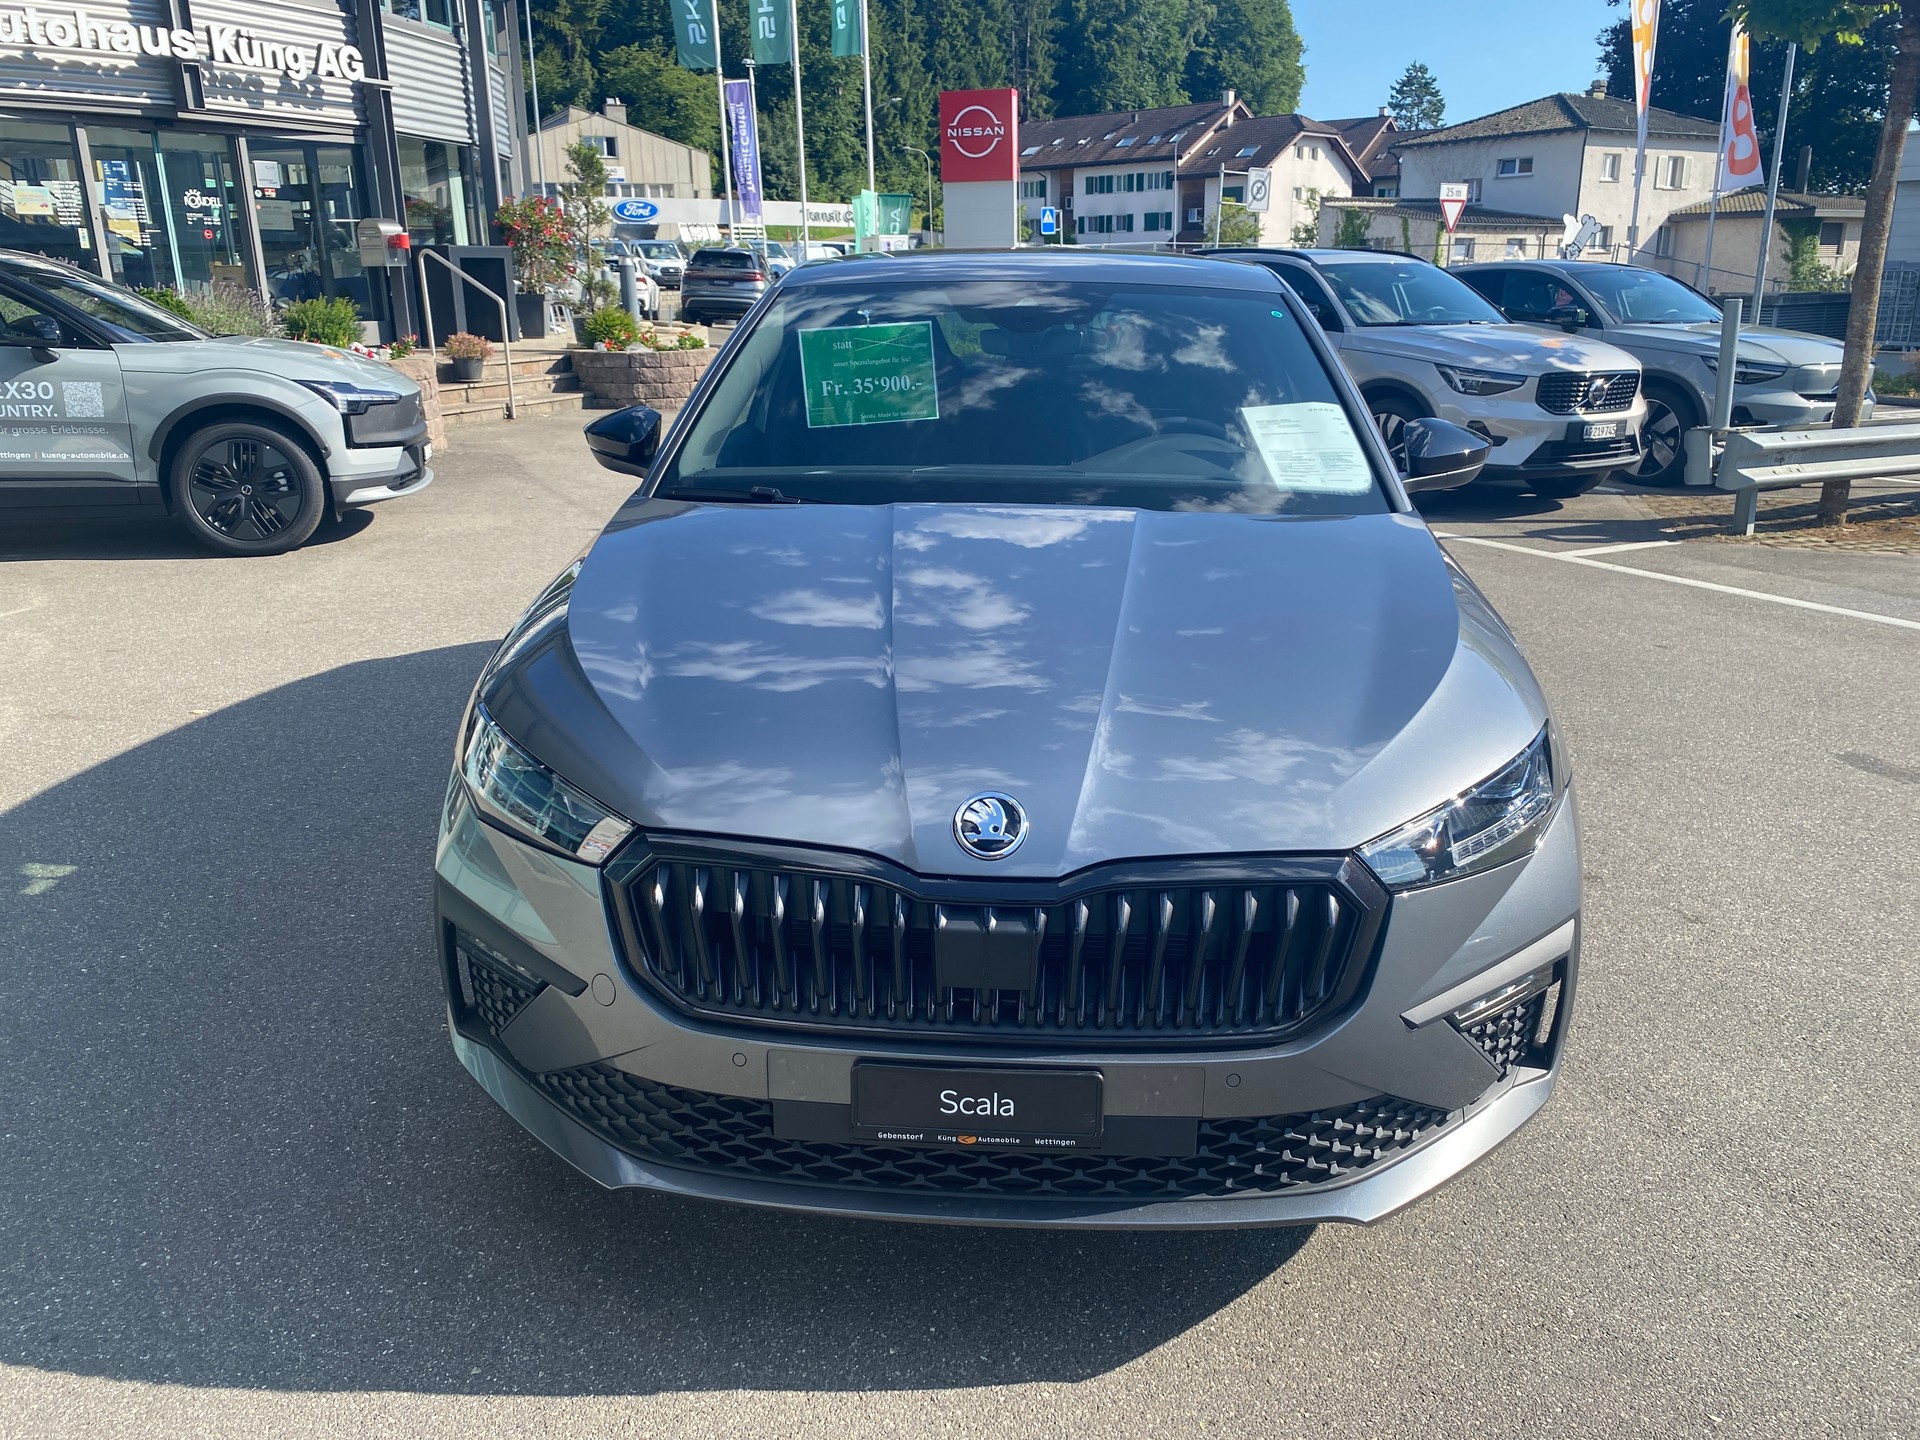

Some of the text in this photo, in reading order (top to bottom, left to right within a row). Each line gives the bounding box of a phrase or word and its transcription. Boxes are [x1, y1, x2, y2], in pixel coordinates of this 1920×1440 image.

[0, 7, 365, 81] utohaus Küng AG
[947, 126, 1005, 137] NISSAN
[1446, 187, 1454, 197] 25
[623, 202, 651, 217] Ford
[832, 340, 852, 350] statt
[849, 357, 891, 368] Spezialangebot
[821, 380, 849, 397] Fr.
[11, 426, 48, 437] grosse
[50, 425, 109, 435] Erlebnisse.
[41, 451, 129, 460] kueng-automobile.ch
[939, 1089, 1015, 1117] Scala
[877, 1132, 1076, 1146] Gebenstorf Küng Automobile Wettingen
